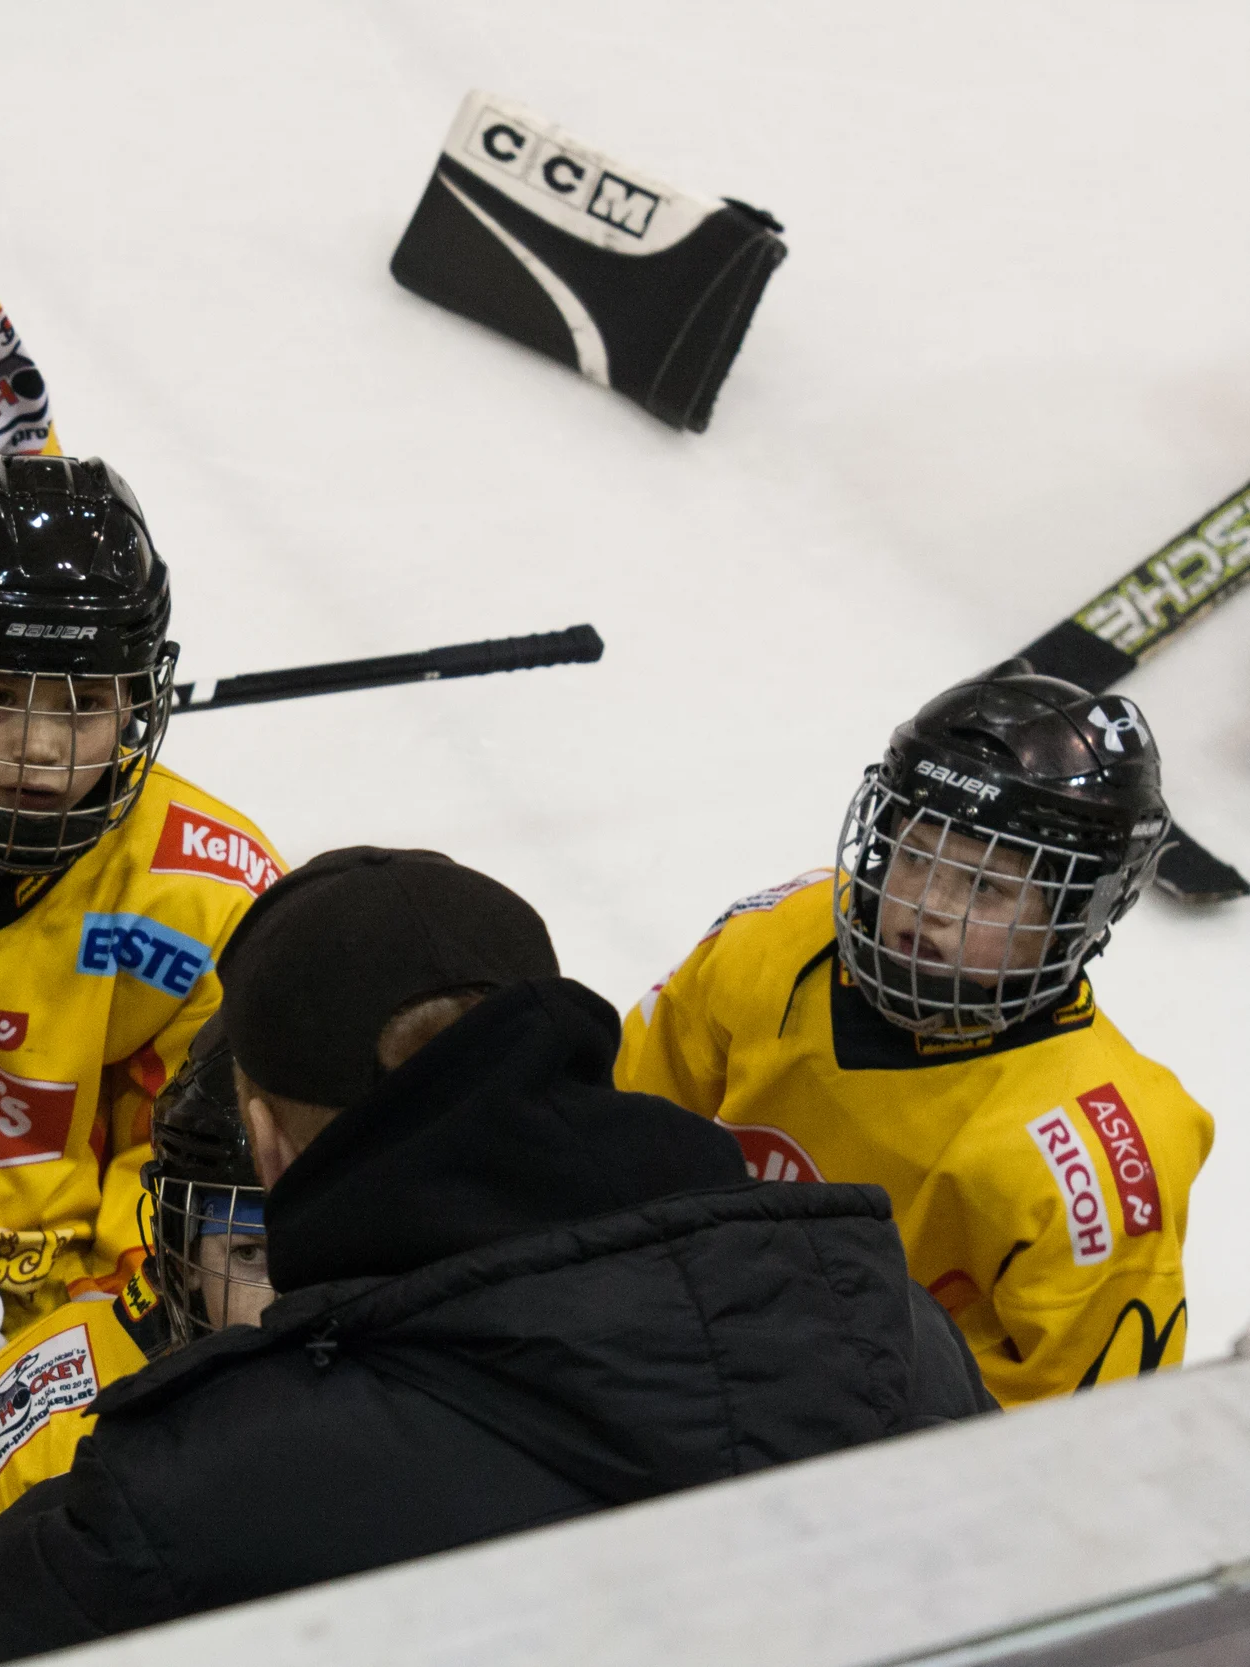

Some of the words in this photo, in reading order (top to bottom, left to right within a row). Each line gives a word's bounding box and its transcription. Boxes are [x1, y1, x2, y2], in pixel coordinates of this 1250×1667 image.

[482, 124, 659, 239] CCM
[5, 623, 99, 640] BAUER
[914, 759, 1002, 802] BAUER
[1088, 1100, 1152, 1185] ASKÖ
[1037, 1117, 1108, 1257] RICOH
